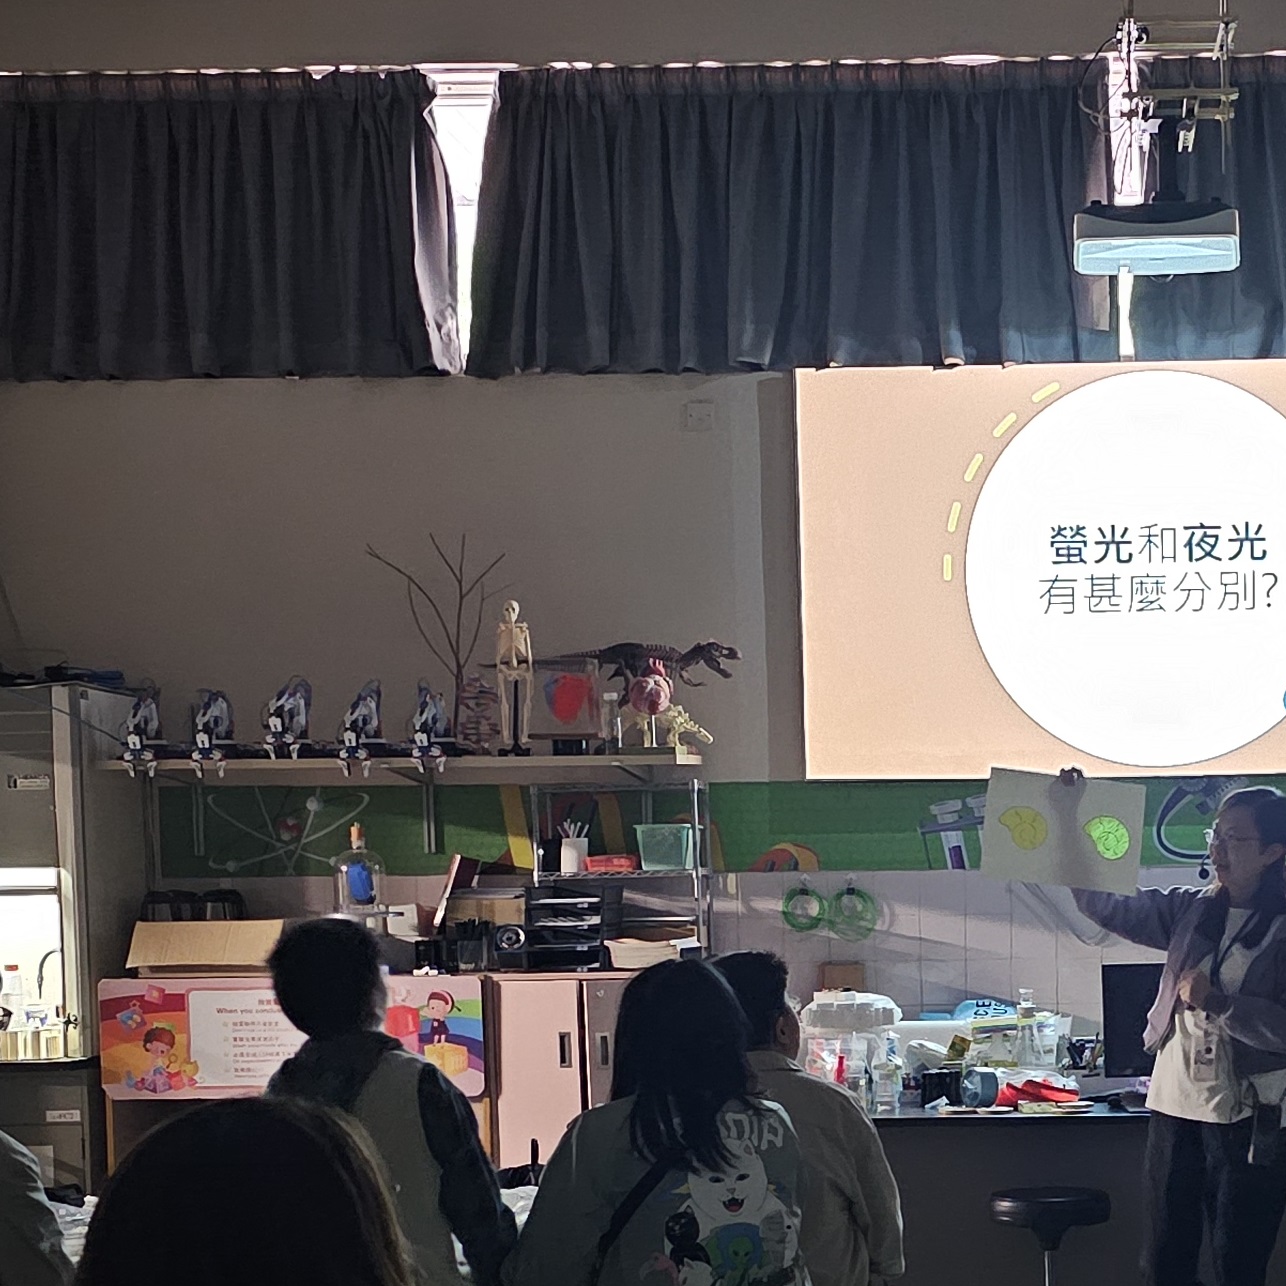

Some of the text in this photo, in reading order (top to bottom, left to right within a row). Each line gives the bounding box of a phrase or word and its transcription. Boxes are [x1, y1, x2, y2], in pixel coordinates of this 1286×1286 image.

[1050, 521, 1267, 564] 螢光和夜光
[1039, 570, 1278, 614] 有甚麼分別?
